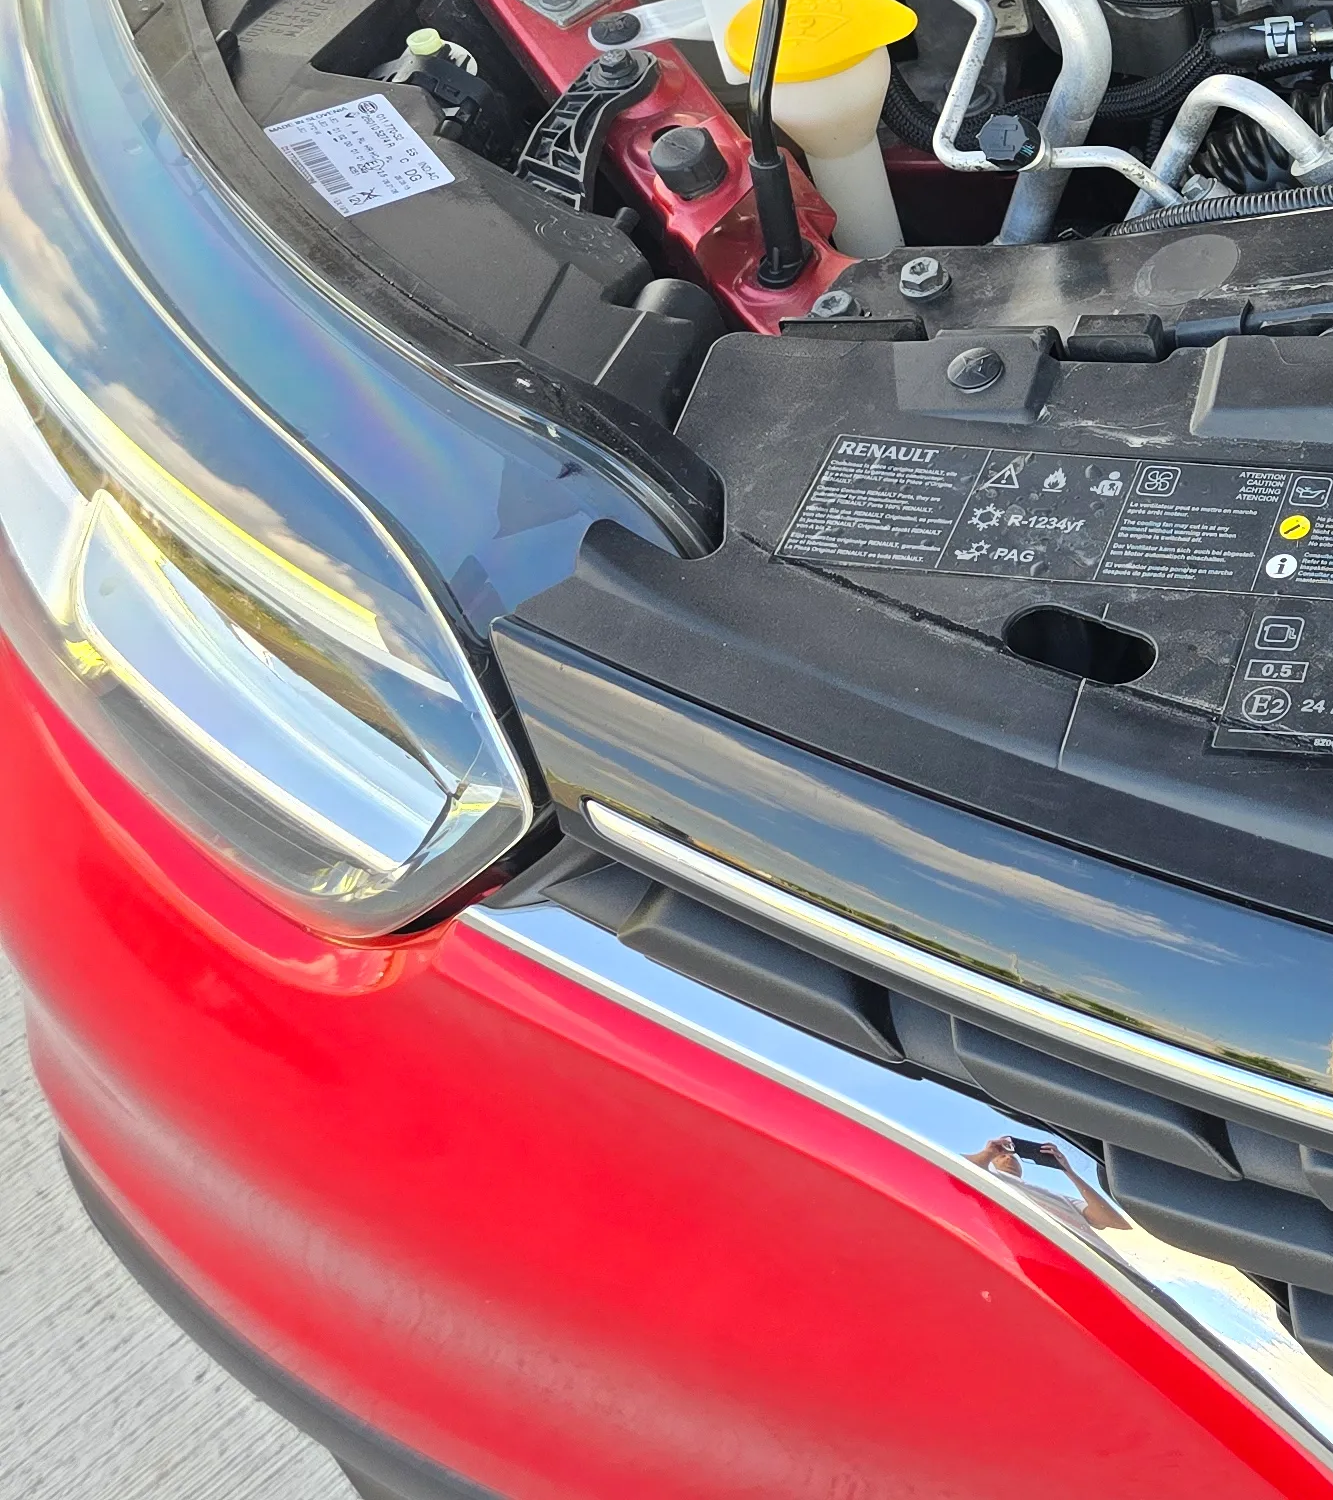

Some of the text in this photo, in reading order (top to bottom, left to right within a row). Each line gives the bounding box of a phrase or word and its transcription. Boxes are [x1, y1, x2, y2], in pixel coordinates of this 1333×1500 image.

[403, 168, 423, 182] DG
[838, 440, 939, 463] RENAULT
[1239, 472, 1286, 480] ATTENTION
[1246, 479, 1283, 487] CAUTION
[1238, 486, 1281, 494] ACHTUNG
[1235, 494, 1278, 502] ATENCION
[1007, 514, 1086, 534] R-1234yf
[993, 548, 1035, 563] PAG
[1262, 665, 1292, 678] 0,5
[1250, 695, 1285, 715] E2
[1301, 700, 1325, 713] 24
